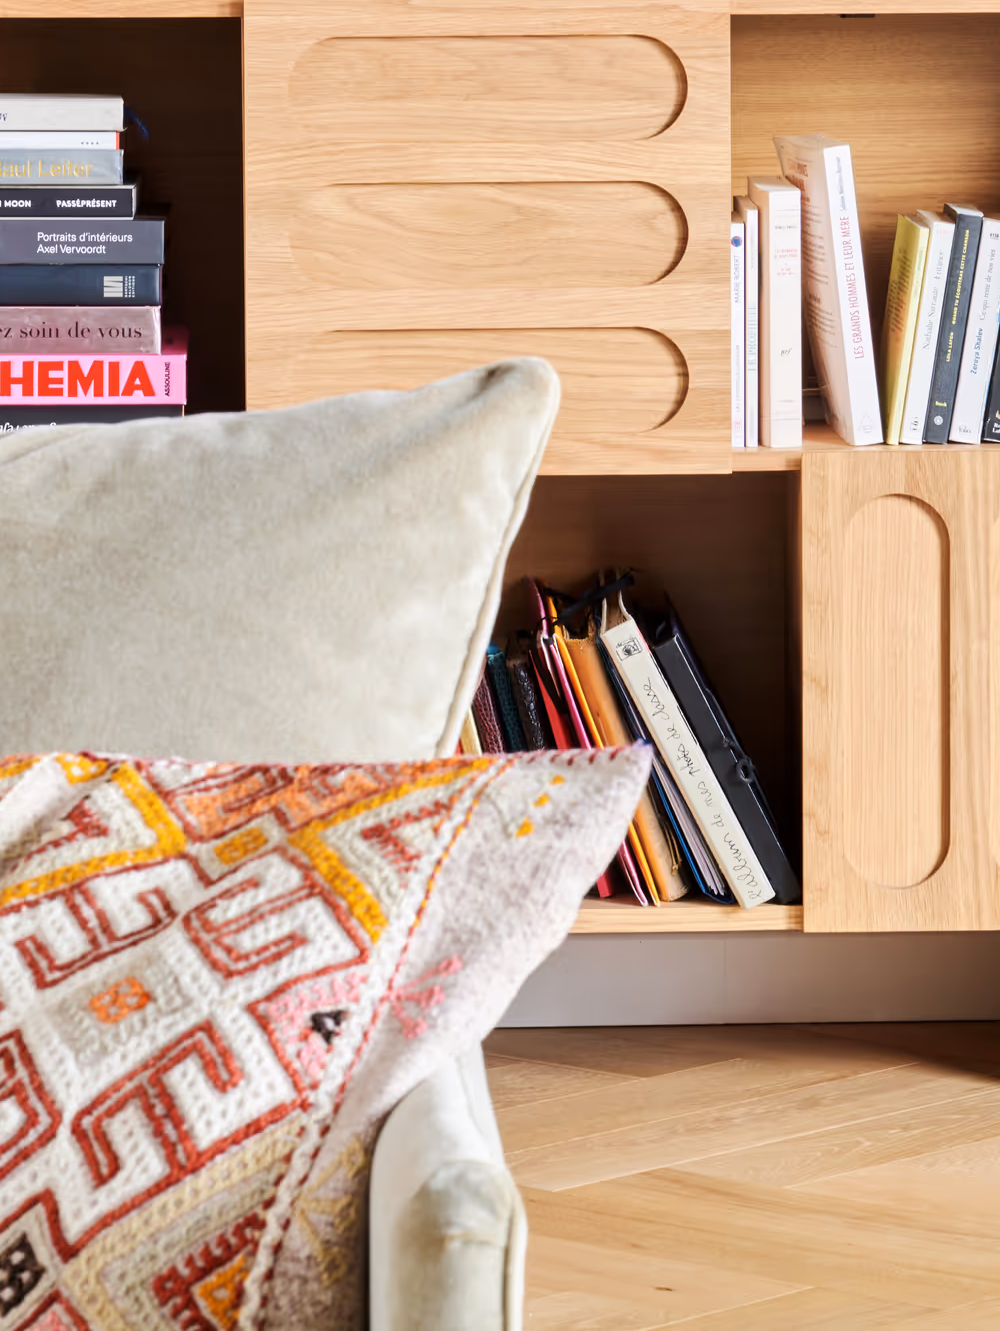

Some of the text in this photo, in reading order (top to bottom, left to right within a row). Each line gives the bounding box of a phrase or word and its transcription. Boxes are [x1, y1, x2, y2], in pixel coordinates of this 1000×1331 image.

[39, 159, 93, 177] Leiter
[4, 200, 32, 208] MOON
[56, 198, 117, 208] PASSÉPRÉSENT
[37, 231, 133, 242] Portraits d'intérieurs
[37, 244, 106, 254] Axel Vervoordt
[842, 239, 854, 260] LEUR
[844, 262, 855, 271] ET
[846, 272, 860, 309] HOMMES
[19, 322, 59, 339] soin
[68, 321, 91, 339] de
[98, 325, 142, 339] vous
[849, 310, 863, 344] GRANDS
[853, 345, 865, 360] LES
[970, 328, 983, 375] Zeruya Shalev
[643, 676, 670, 721] classe
[667, 723, 681, 741] de
[697, 781, 714, 807] mes
[711, 813, 725, 828] de
